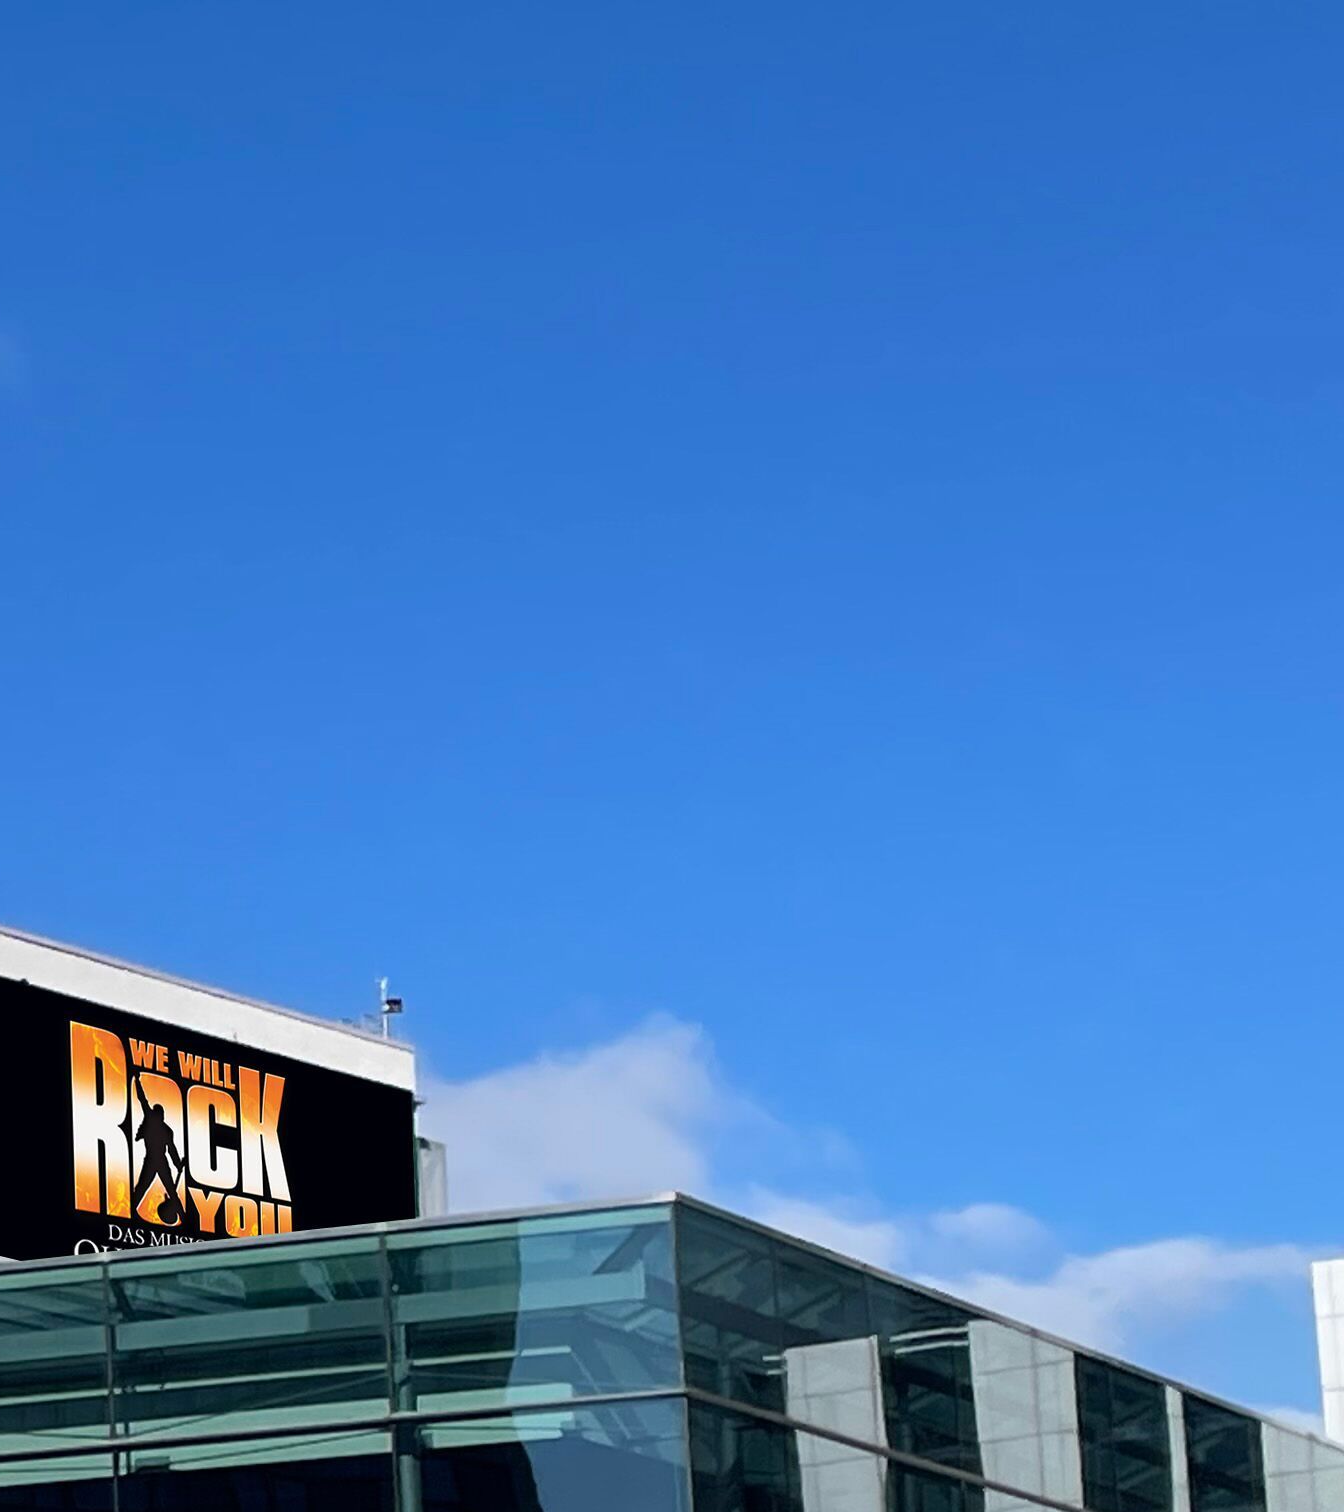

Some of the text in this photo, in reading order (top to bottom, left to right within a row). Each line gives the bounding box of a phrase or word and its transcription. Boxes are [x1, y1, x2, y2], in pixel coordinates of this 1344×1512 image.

[129, 1037, 236, 1090] WE WILL
[69, 1020, 292, 1226] ROCK
[108, 1224, 145, 1245] DAS
